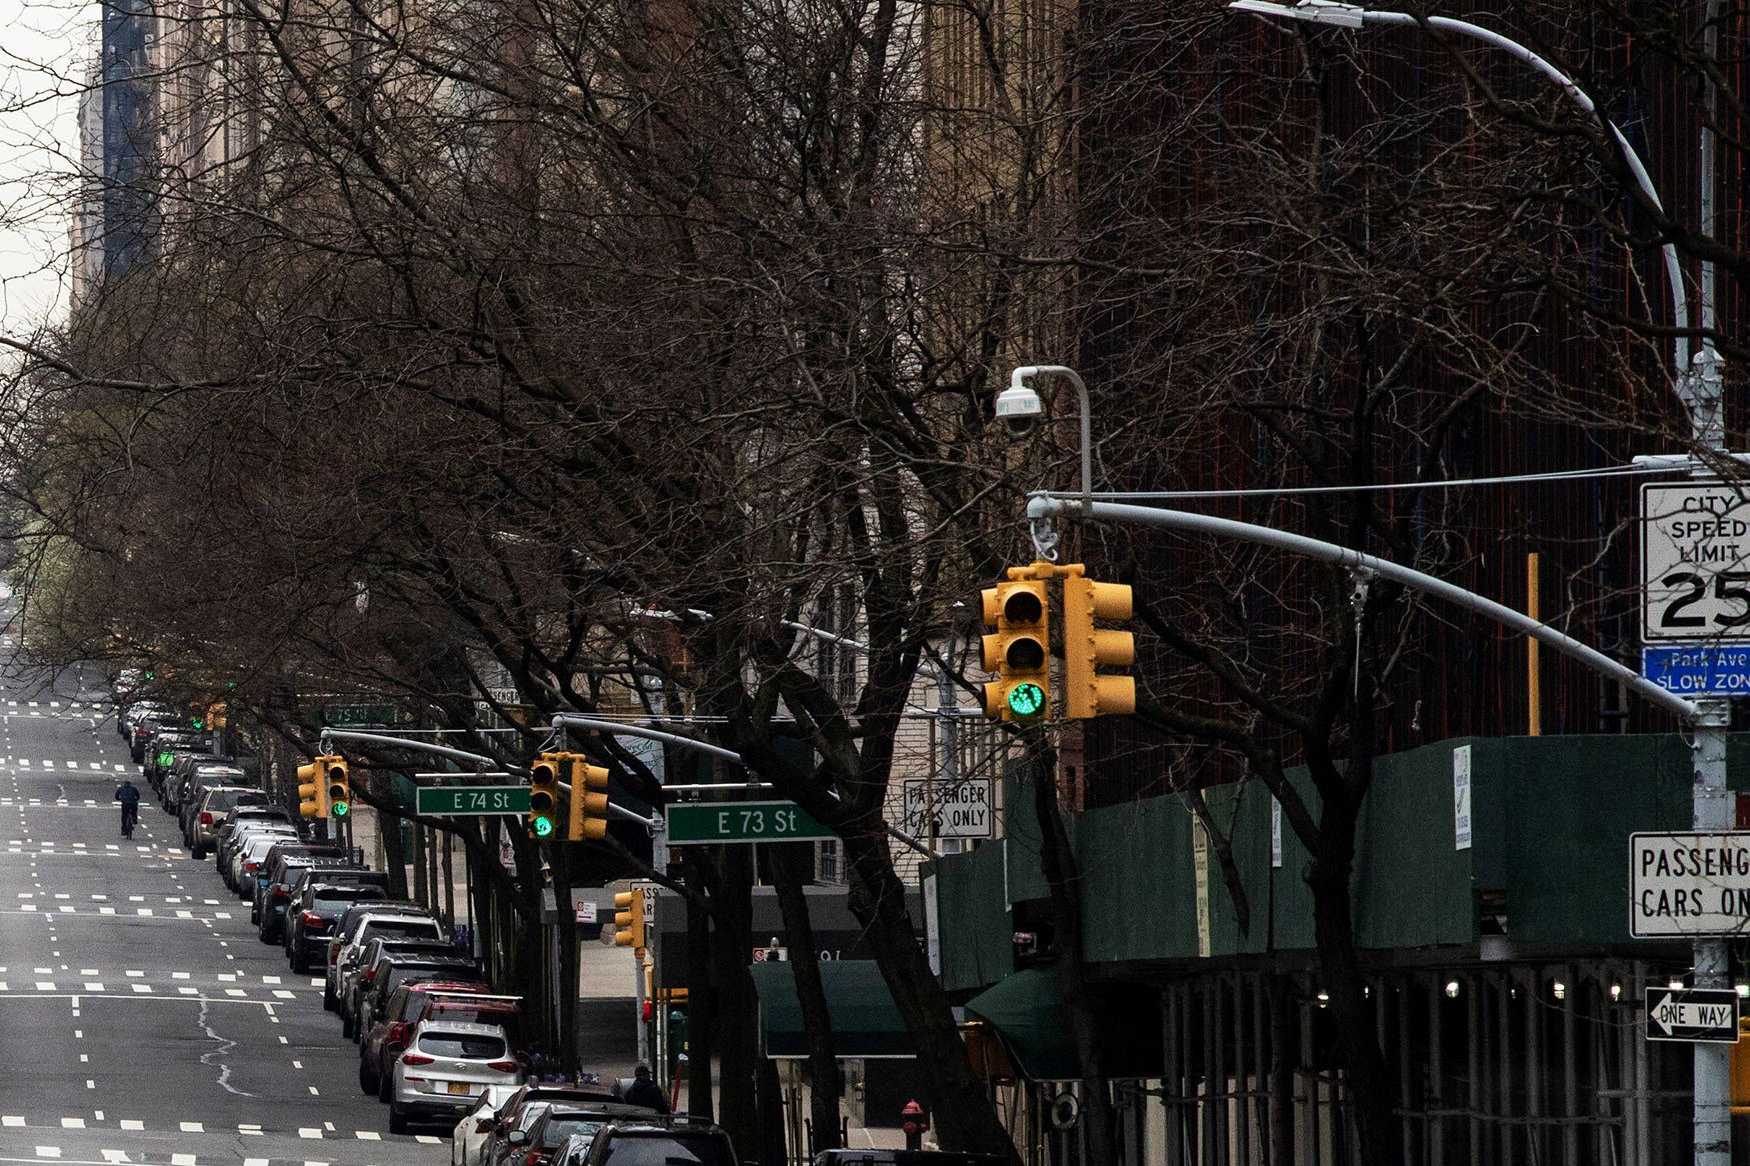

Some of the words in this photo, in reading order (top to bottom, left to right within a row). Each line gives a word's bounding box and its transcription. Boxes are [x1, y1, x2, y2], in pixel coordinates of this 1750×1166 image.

[1683, 496, 1735, 513] CITY
[1671, 521, 1747, 538] SPEED
[1681, 545, 1739, 563] LIMIT
[1661, 572, 1750, 628] 25
[1671, 652, 1710, 667] Park
[1656, 674, 1708, 690] SLOW
[454, 793, 463, 808] E
[469, 793, 487, 808] 74
[493, 793, 509, 808] St
[910, 786, 985, 804] PASENGER
[718, 811, 730, 833] E
[739, 811, 764, 833] 73
[775, 810, 797, 832] St
[953, 809, 985, 827] ONLY
[1642, 888, 1703, 917] CARS
[1660, 1004, 1686, 1024] ONE
[1698, 1006, 1726, 1026] WAY
